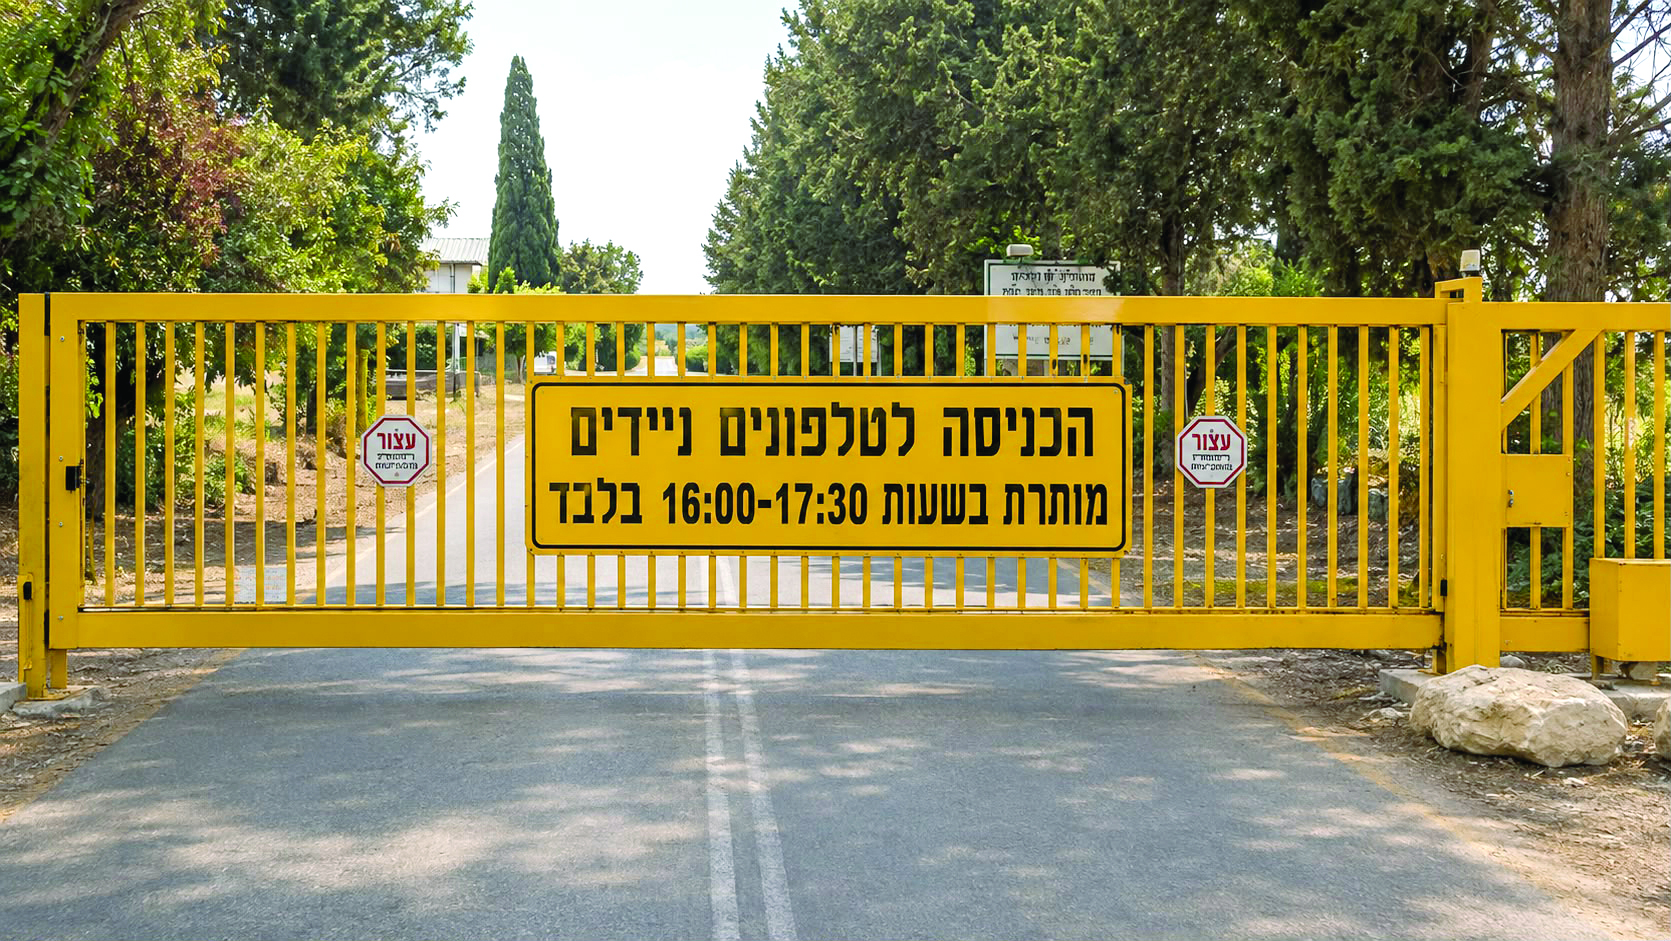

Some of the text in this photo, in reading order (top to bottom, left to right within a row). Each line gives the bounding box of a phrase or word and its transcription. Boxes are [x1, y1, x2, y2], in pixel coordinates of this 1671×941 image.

[376, 432, 416, 450] עצור
[571, 401, 1093, 457] הכניסה לטלפונים ניידים
[1191, 433, 1231, 451] עצור
[549, 477, 1108, 526] מותרת בשעות 16:00-17:30 בלבד
